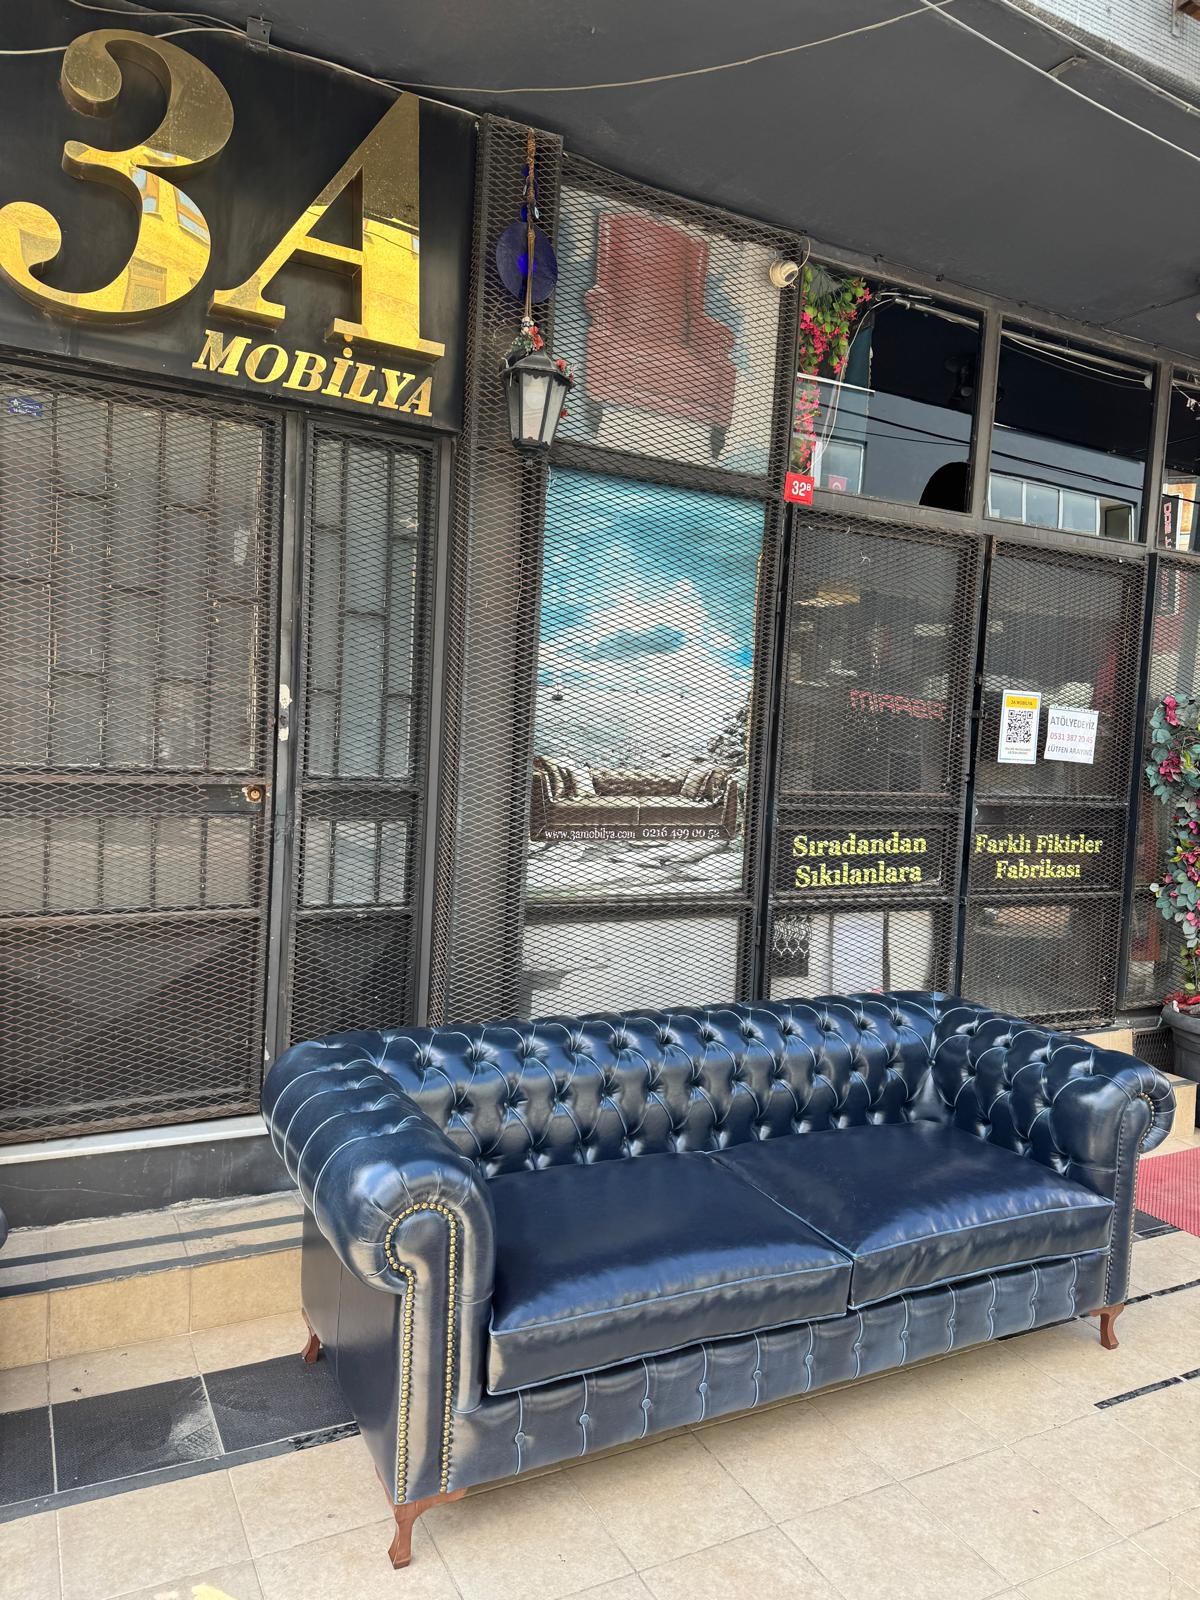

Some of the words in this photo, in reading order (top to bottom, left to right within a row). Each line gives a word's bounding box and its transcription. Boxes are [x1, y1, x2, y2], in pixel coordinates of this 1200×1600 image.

[0, 28, 445, 358] 3A
[191, 329, 433, 417] MOBİLYA
[1047, 744, 1069, 754] LÜTFEN
[545, 827, 636, 841] www.3amobilya.com
[643, 827, 667, 838] 0216
[671, 828, 689, 841] 499
[792, 831, 927, 857] Sıradandan
[975, 833, 1032, 854] Farklı
[1036, 833, 1104, 854] Fikirler
[795, 860, 923, 888] Sıkılanlara
[995, 858, 1081, 879] Fabrikası
